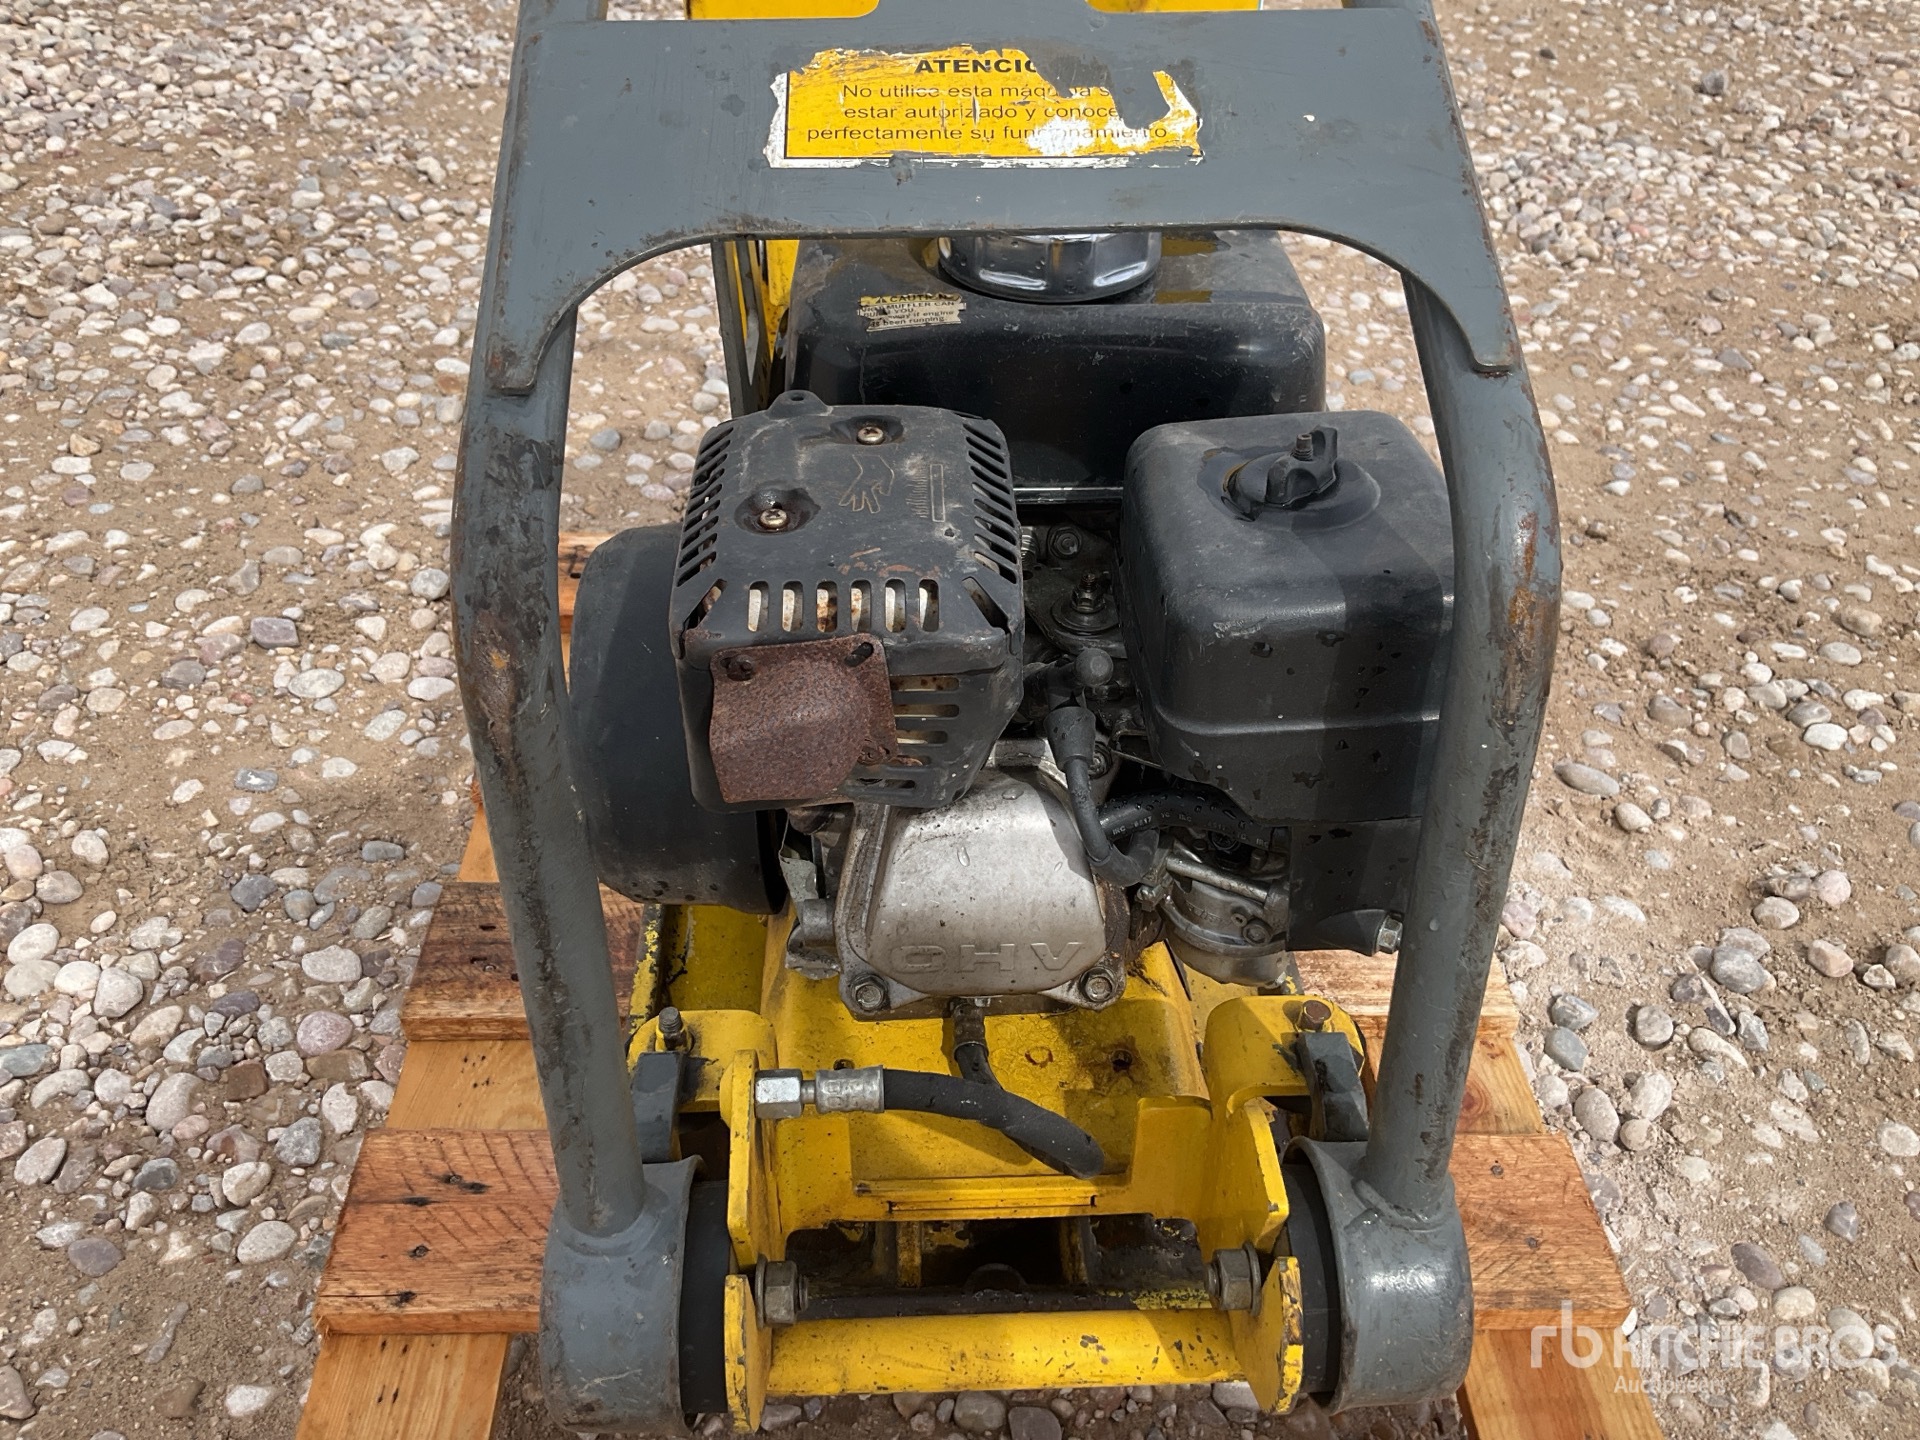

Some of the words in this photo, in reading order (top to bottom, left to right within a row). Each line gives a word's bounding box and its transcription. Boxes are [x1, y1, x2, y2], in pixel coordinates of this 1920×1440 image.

[843, 84, 872, 98] No
[880, 84, 940, 98] utilice
[949, 84, 992, 98] esta
[844, 106, 897, 119] estar
[905, 104, 1017, 119] autorizado
[1026, 107, 1037, 122] y
[1044, 106, 1118, 118] conoce
[808, 125, 963, 142] perfectamente
[970, 128, 995, 140] su
[886, 301, 931, 310] MUFFLER
[890, 941, 1085, 975] OHV
